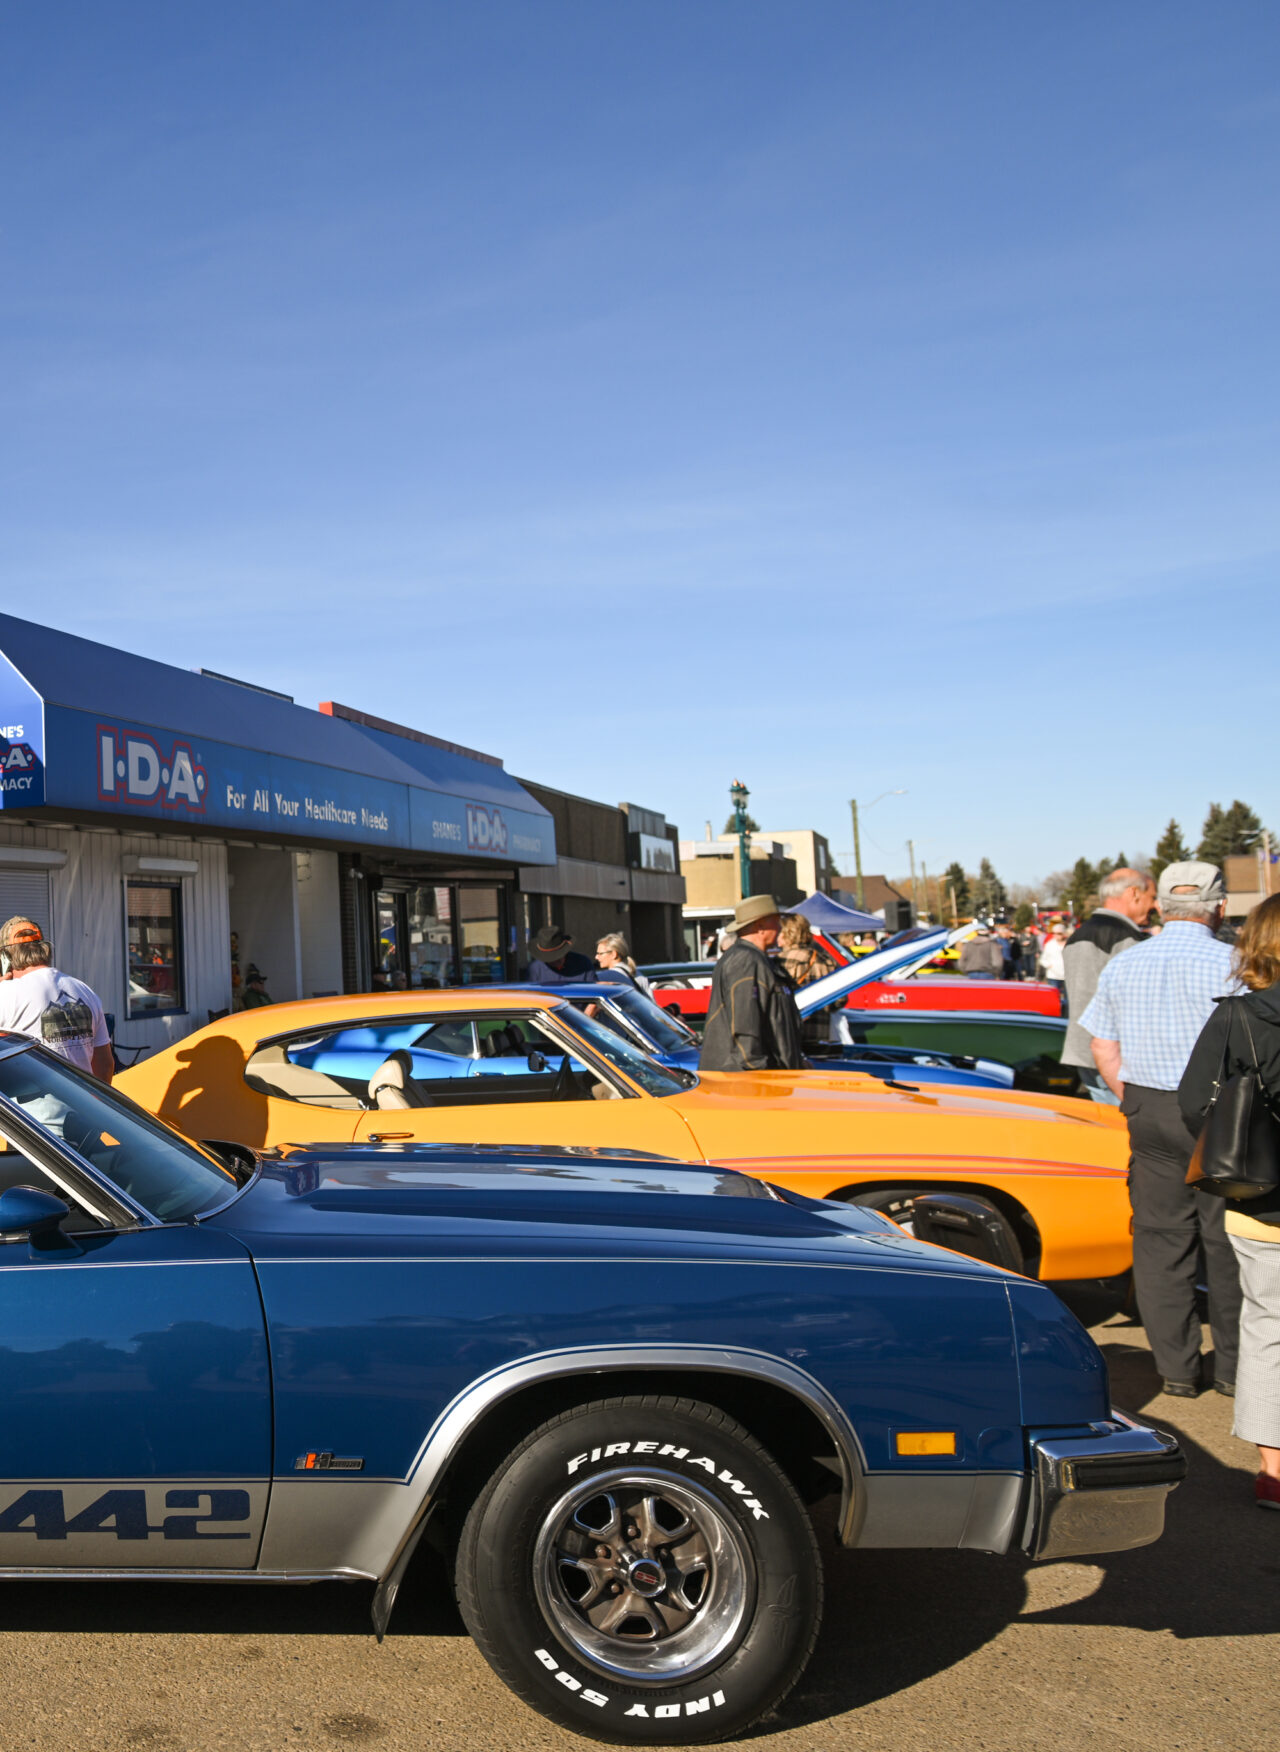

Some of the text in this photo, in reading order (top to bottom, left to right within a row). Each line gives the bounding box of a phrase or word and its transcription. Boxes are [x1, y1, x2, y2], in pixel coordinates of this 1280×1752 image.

[226, 785, 389, 831] For All Your Healthcare Needs
[567, 1441, 770, 1520] FIREHAWK
[534, 1648, 726, 1718] INDY 500
